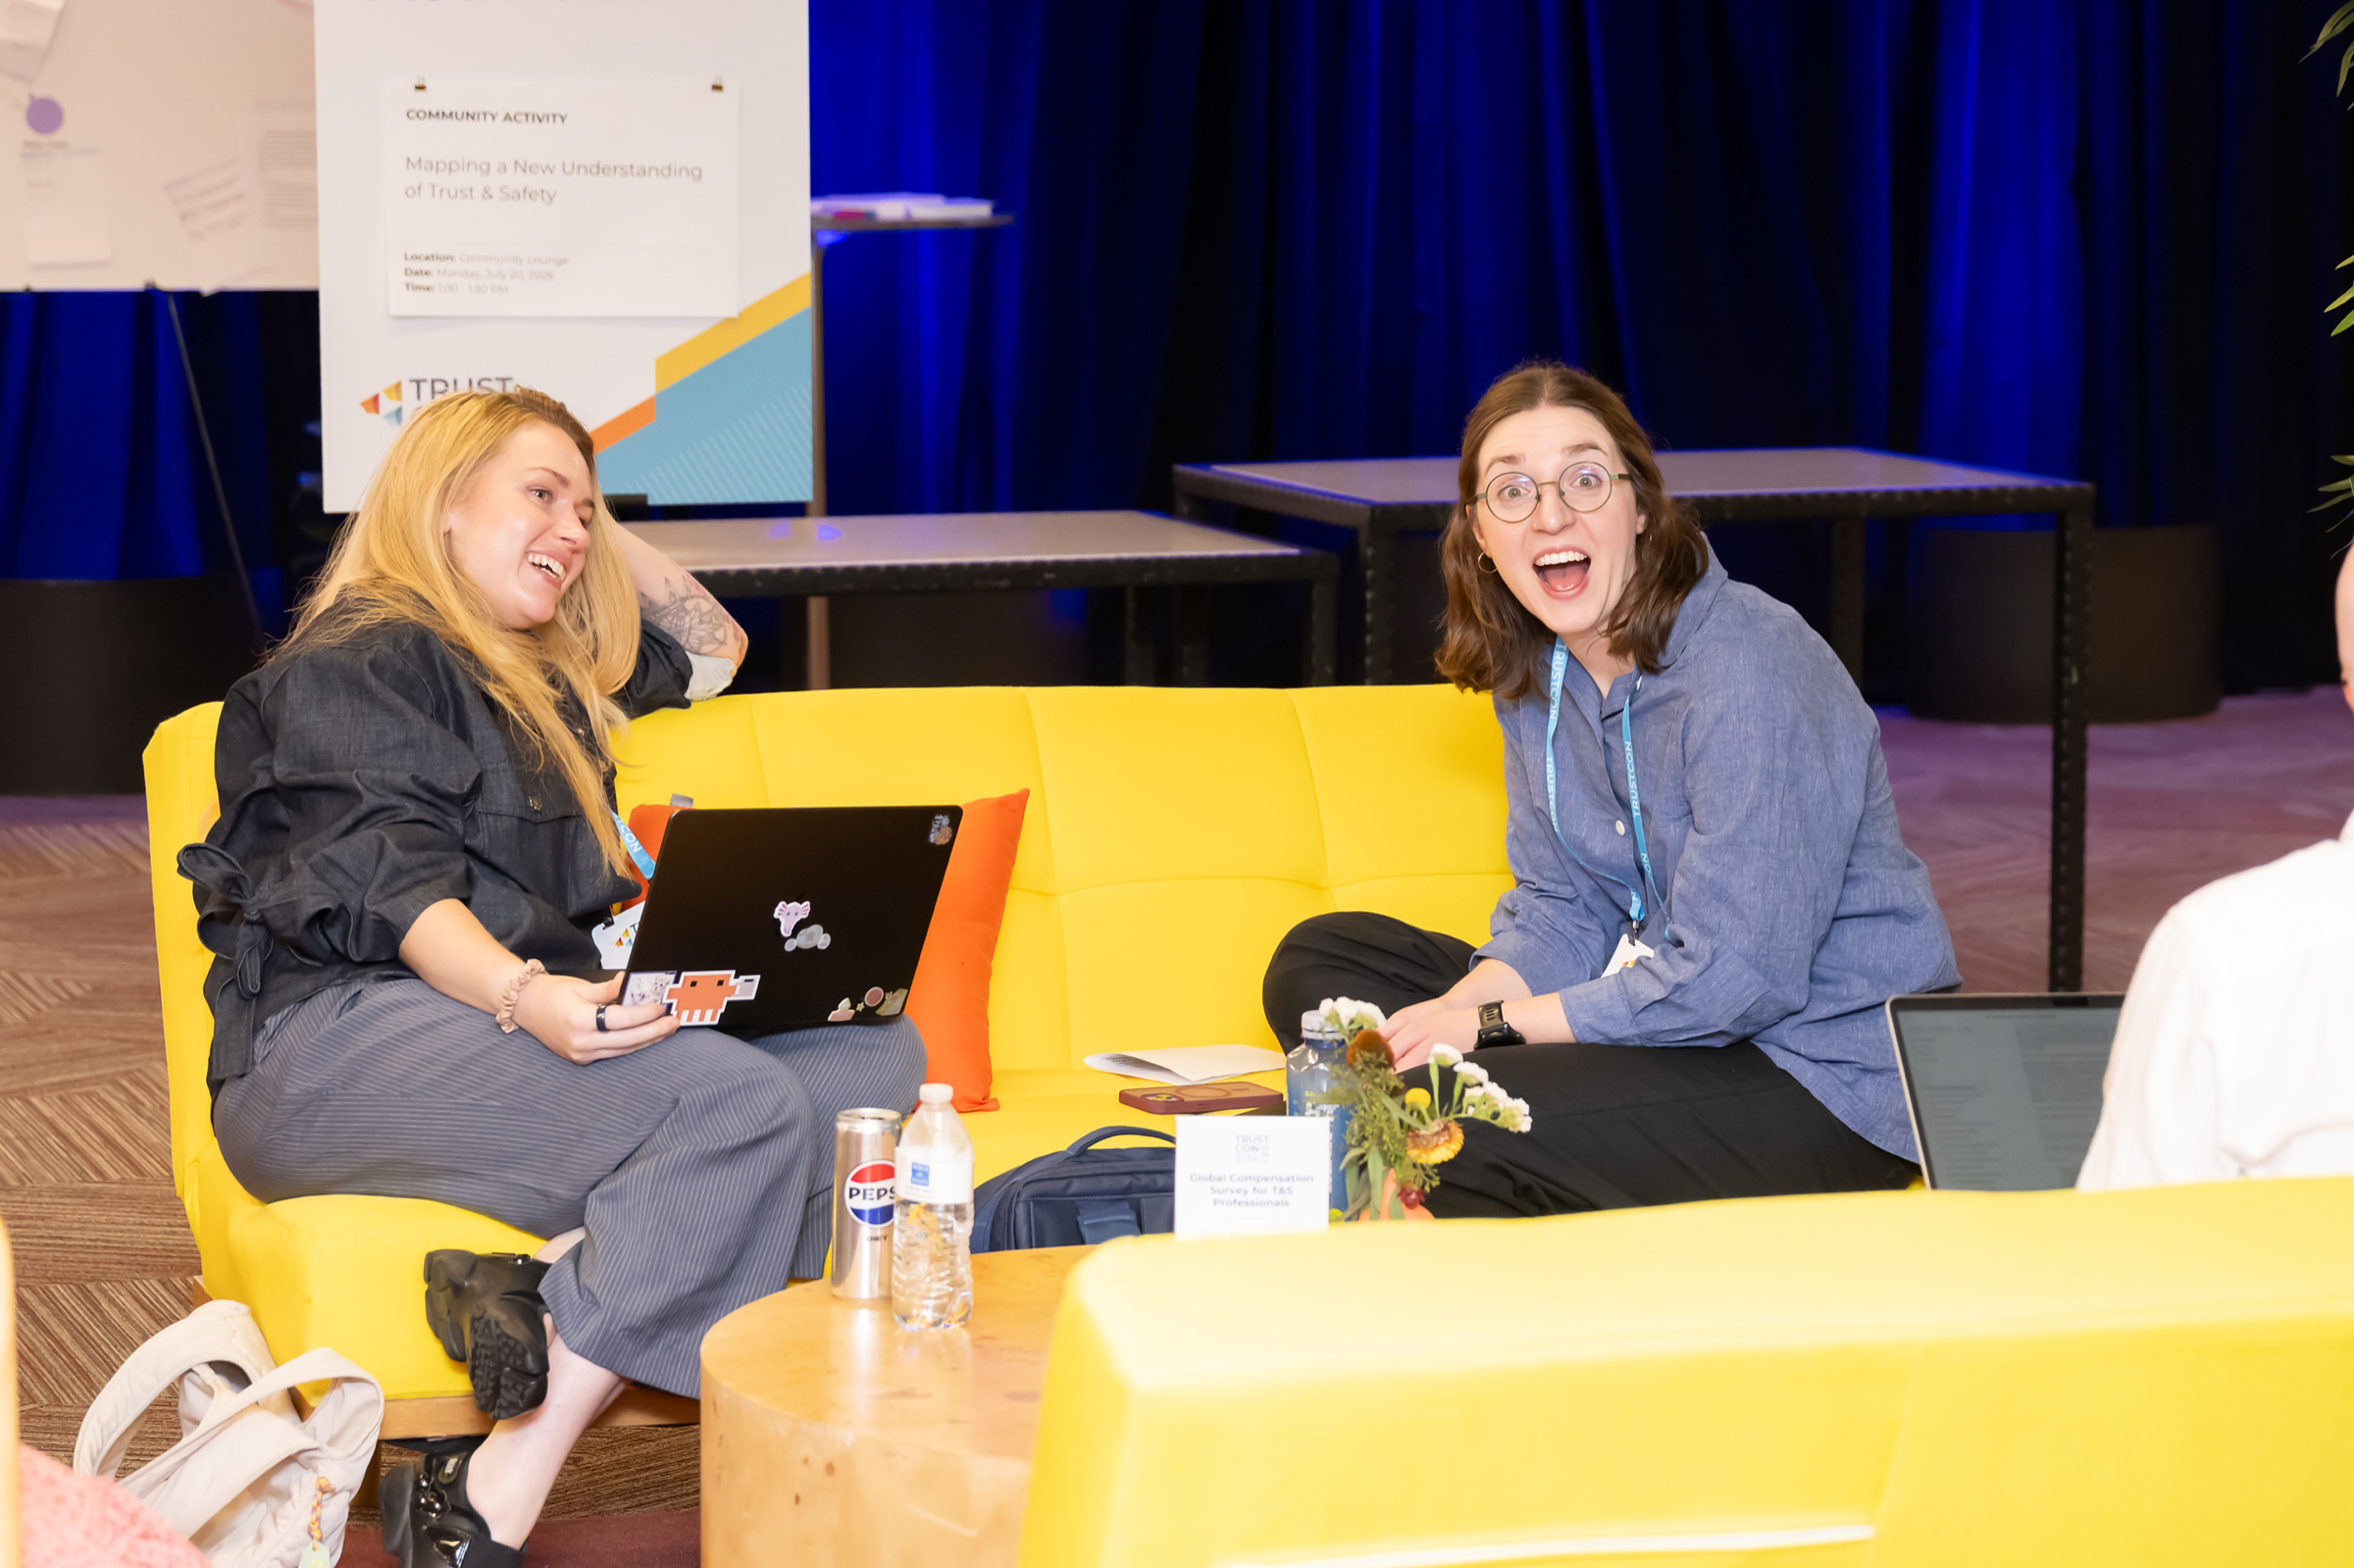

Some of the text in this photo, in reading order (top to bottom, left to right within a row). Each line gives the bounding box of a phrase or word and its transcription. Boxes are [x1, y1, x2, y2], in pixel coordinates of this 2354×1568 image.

[406, 109, 568, 125] COMMUNITY ACTIVITY
[405, 156, 703, 183] Mapping a New Understanding
[405, 182, 557, 206] of Trust & Safety
[404, 252, 569, 268] Location: Community Lounge
[404, 267, 435, 278] Date:
[485, 269, 507, 280] July
[404, 281, 435, 292] Time:
[1549, 643, 1567, 720] TRUSTCON
[1624, 740, 1641, 818] TRUSTCON
[1235, 1135, 1269, 1143] TRUST
[1235, 1144, 1259, 1153] CON
[1190, 1173, 1314, 1184] Global Compensation
[848, 1186, 896, 1201] PEPS
[1210, 1186, 1294, 1196] Survey for T&S
[1213, 1197, 1290, 1208] Professionals
